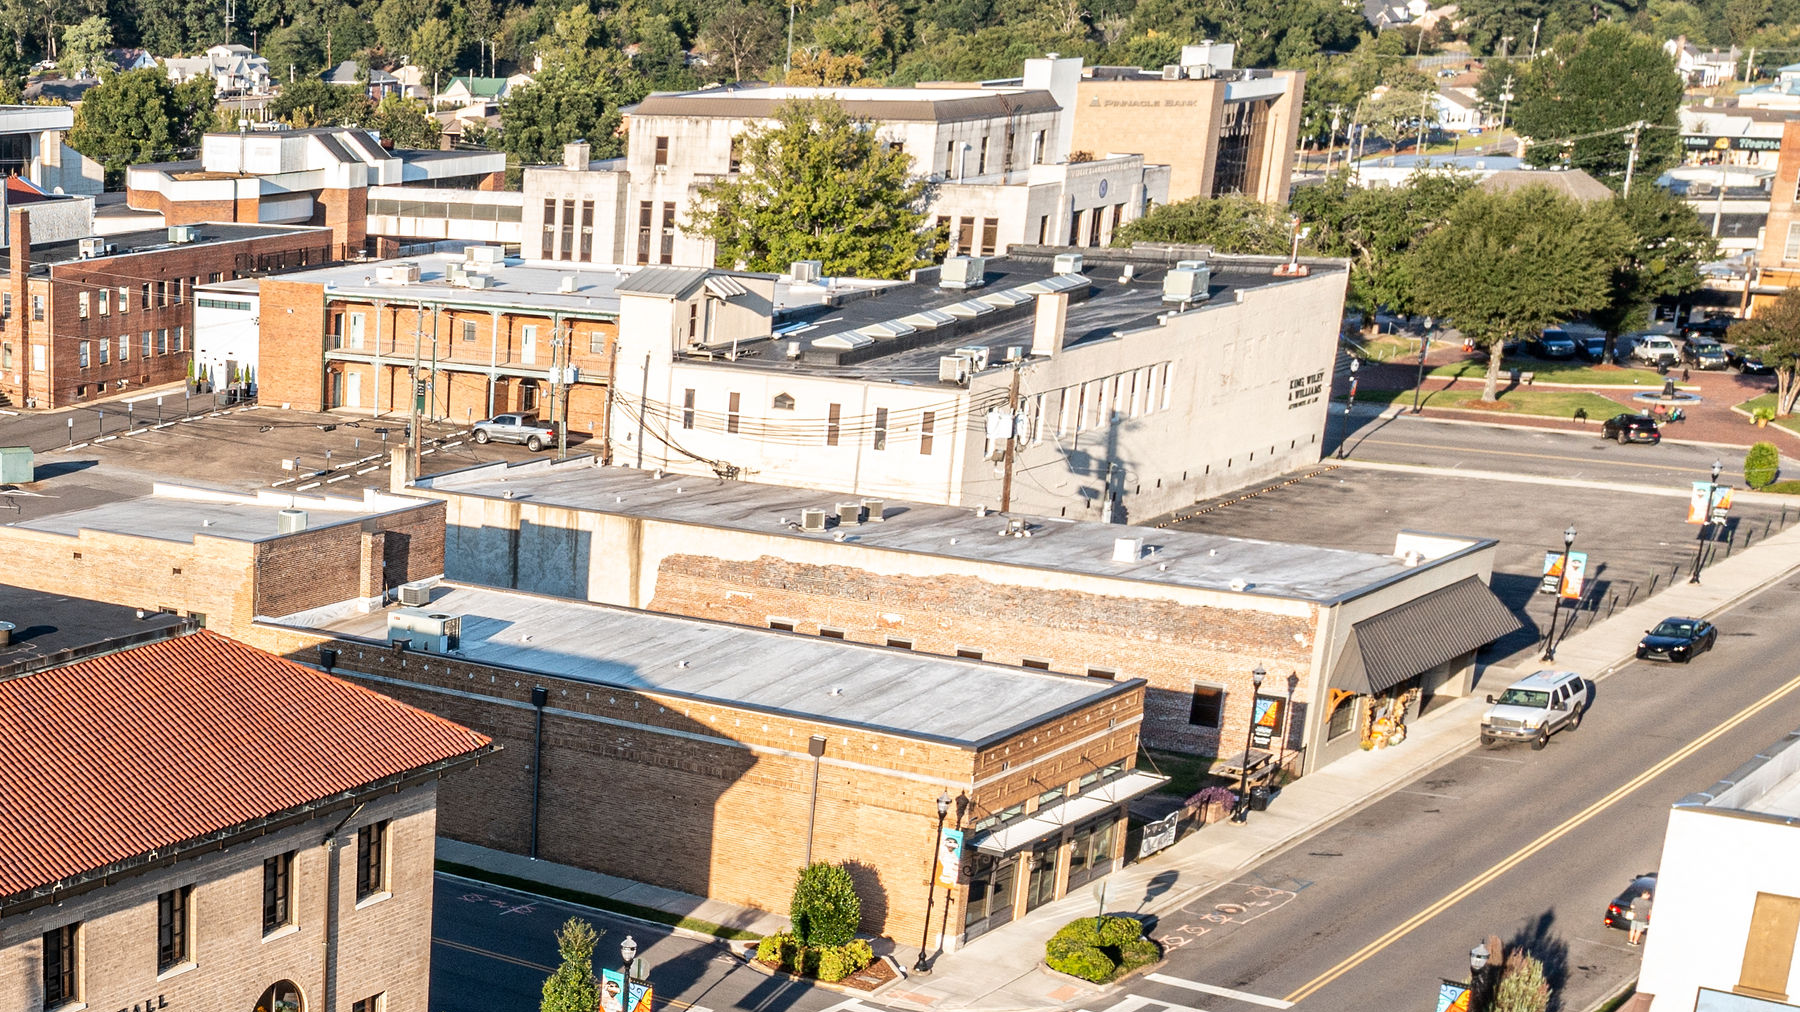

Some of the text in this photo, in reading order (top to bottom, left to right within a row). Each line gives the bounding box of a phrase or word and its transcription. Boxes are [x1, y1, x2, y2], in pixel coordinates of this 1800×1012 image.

[1104, 99, 1198, 107] PINNACLE BANK
[1295, 384, 1322, 399] WILLIAMS
